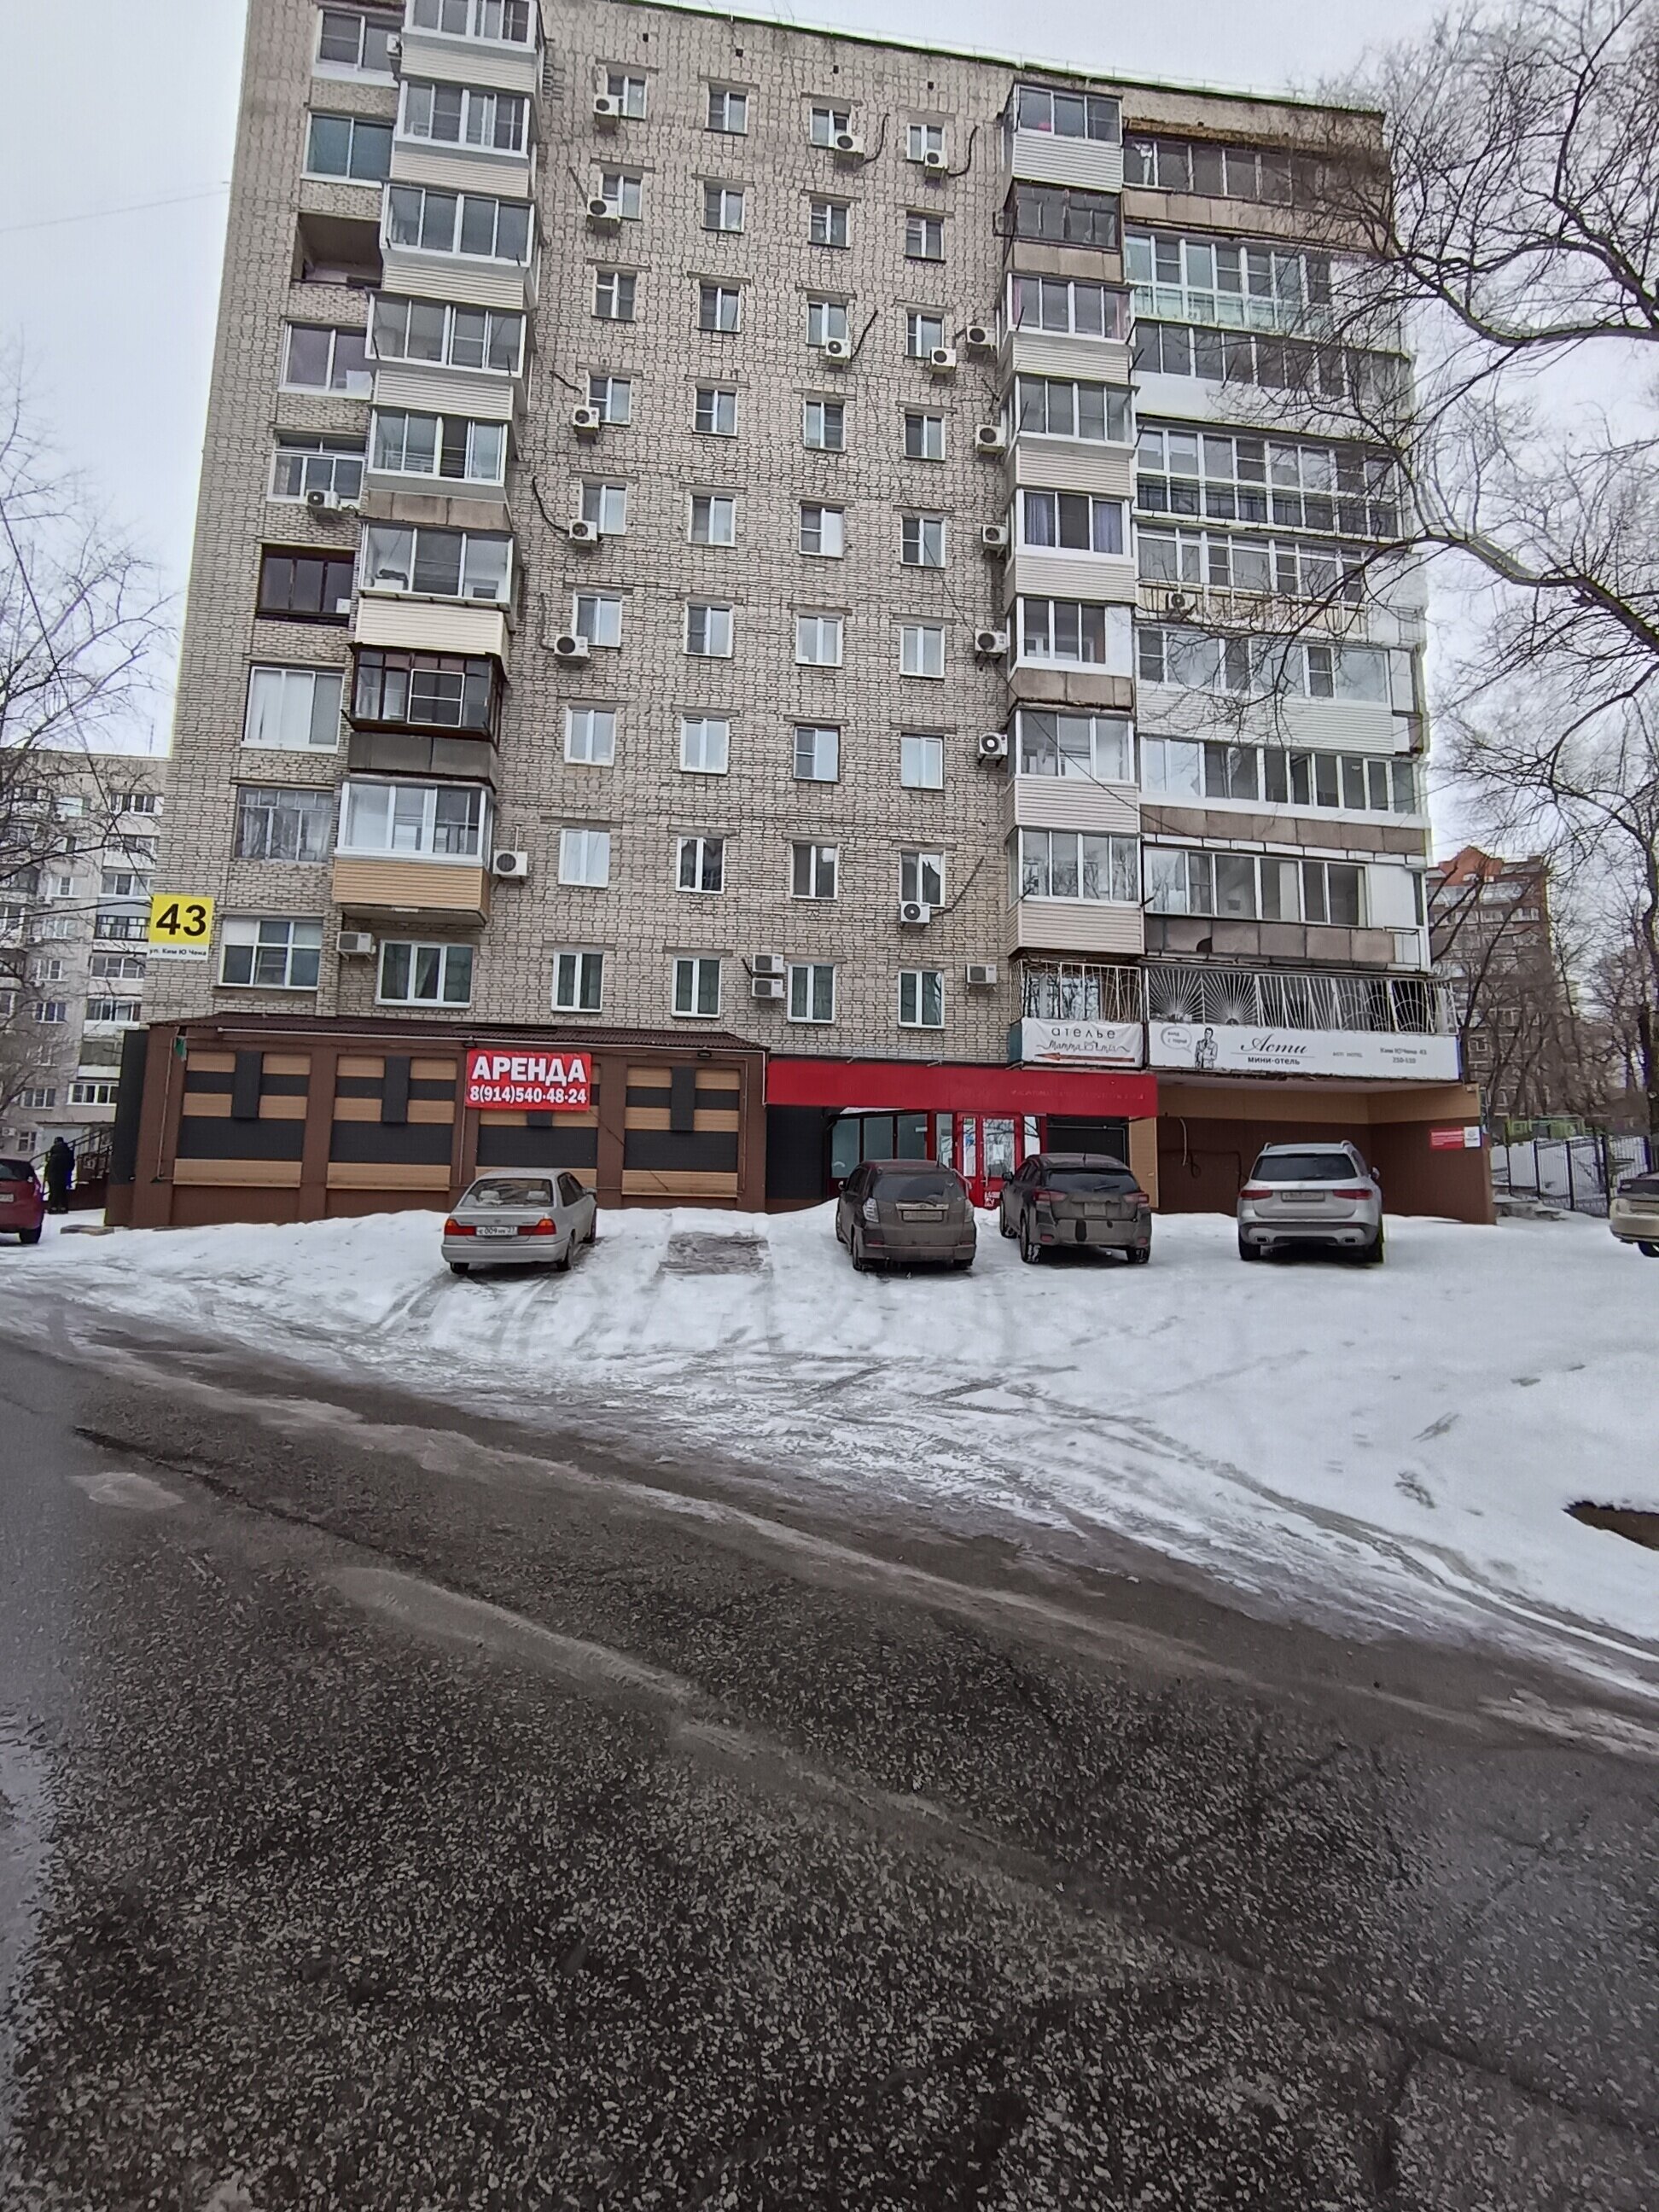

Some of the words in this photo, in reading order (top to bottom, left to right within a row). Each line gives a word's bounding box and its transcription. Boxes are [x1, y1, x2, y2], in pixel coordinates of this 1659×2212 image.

[155, 903, 207, 936] 43
[1051, 1027, 1115, 1039] ателье
[1240, 1033, 1307, 1055] Асти
[471, 1056, 586, 1086] АРЕНДА
